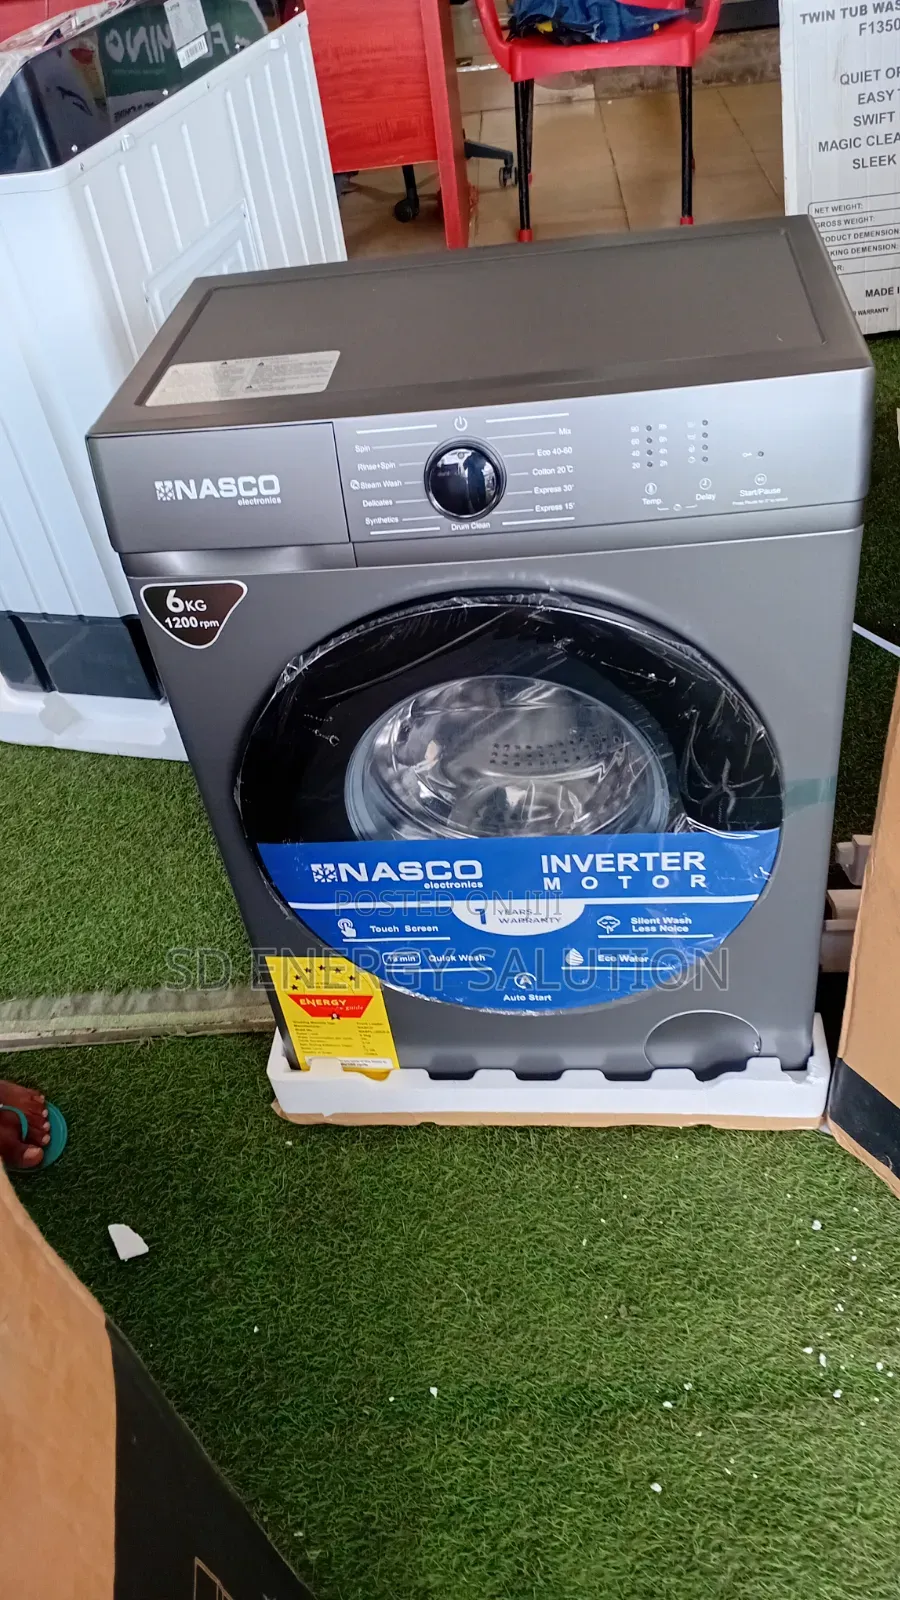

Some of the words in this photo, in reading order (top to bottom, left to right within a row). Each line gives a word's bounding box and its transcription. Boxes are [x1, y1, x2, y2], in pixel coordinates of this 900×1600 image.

[800, 9, 836, 25] TWIN
[840, 4, 868, 19] TUB
[859, 17, 900, 36] F1350
[839, 68, 882, 86] QUIET
[857, 89, 895, 105] EASY
[853, 111, 896, 127] SWIFT
[818, 137, 862, 152] MAGIC
[866, 131, 900, 147] CLEA
[852, 153, 897, 170] SLEEK
[814, 206, 830, 214] NET
[828, 248, 849, 256] KING
[865, 286, 894, 298] MADE
[858, 307, 889, 316] WARRANTY
[558, 427, 572, 435] Mix
[354, 444, 371, 454] Spin
[537, 448, 551, 457] Eco
[357, 461, 396, 471] Rinse+Spin
[532, 467, 556, 476] Cotton
[173, 474, 281, 500] NASCO
[360, 481, 382, 490] Steam
[383, 479, 402, 489] Wash
[533, 485, 562, 495] Express
[739, 487, 782, 497] Start/Pause
[237, 496, 282, 507] electronics
[362, 498, 393, 507] Delicates
[695, 493, 716, 502] Delay
[535, 503, 563, 512] Express
[365, 515, 399, 526] Synthetics
[451, 523, 470, 531] Drum
[471, 521, 491, 529] Clean
[164, 616, 199, 629] 1200
[200, 618, 220, 630] rpm
[541, 851, 707, 874] INVERTER
[337, 859, 484, 882] NASCO
[423, 880, 484, 889] electronics
[630, 916, 661, 925] Silent
[662, 916, 692, 925] Wash
[370, 925, 400, 933] Touch
[404, 924, 439, 933] Screen
[632, 925, 657, 933] Less
[429, 954, 457, 963] Quick
[458, 954, 486, 962] Wash
[598, 954, 617, 962] Eco
[618, 955, 649, 963] Water
[299, 997, 347, 1008] ENERGY
[504, 994, 526, 1002] Auto
[528, 993, 552, 1002] Start
